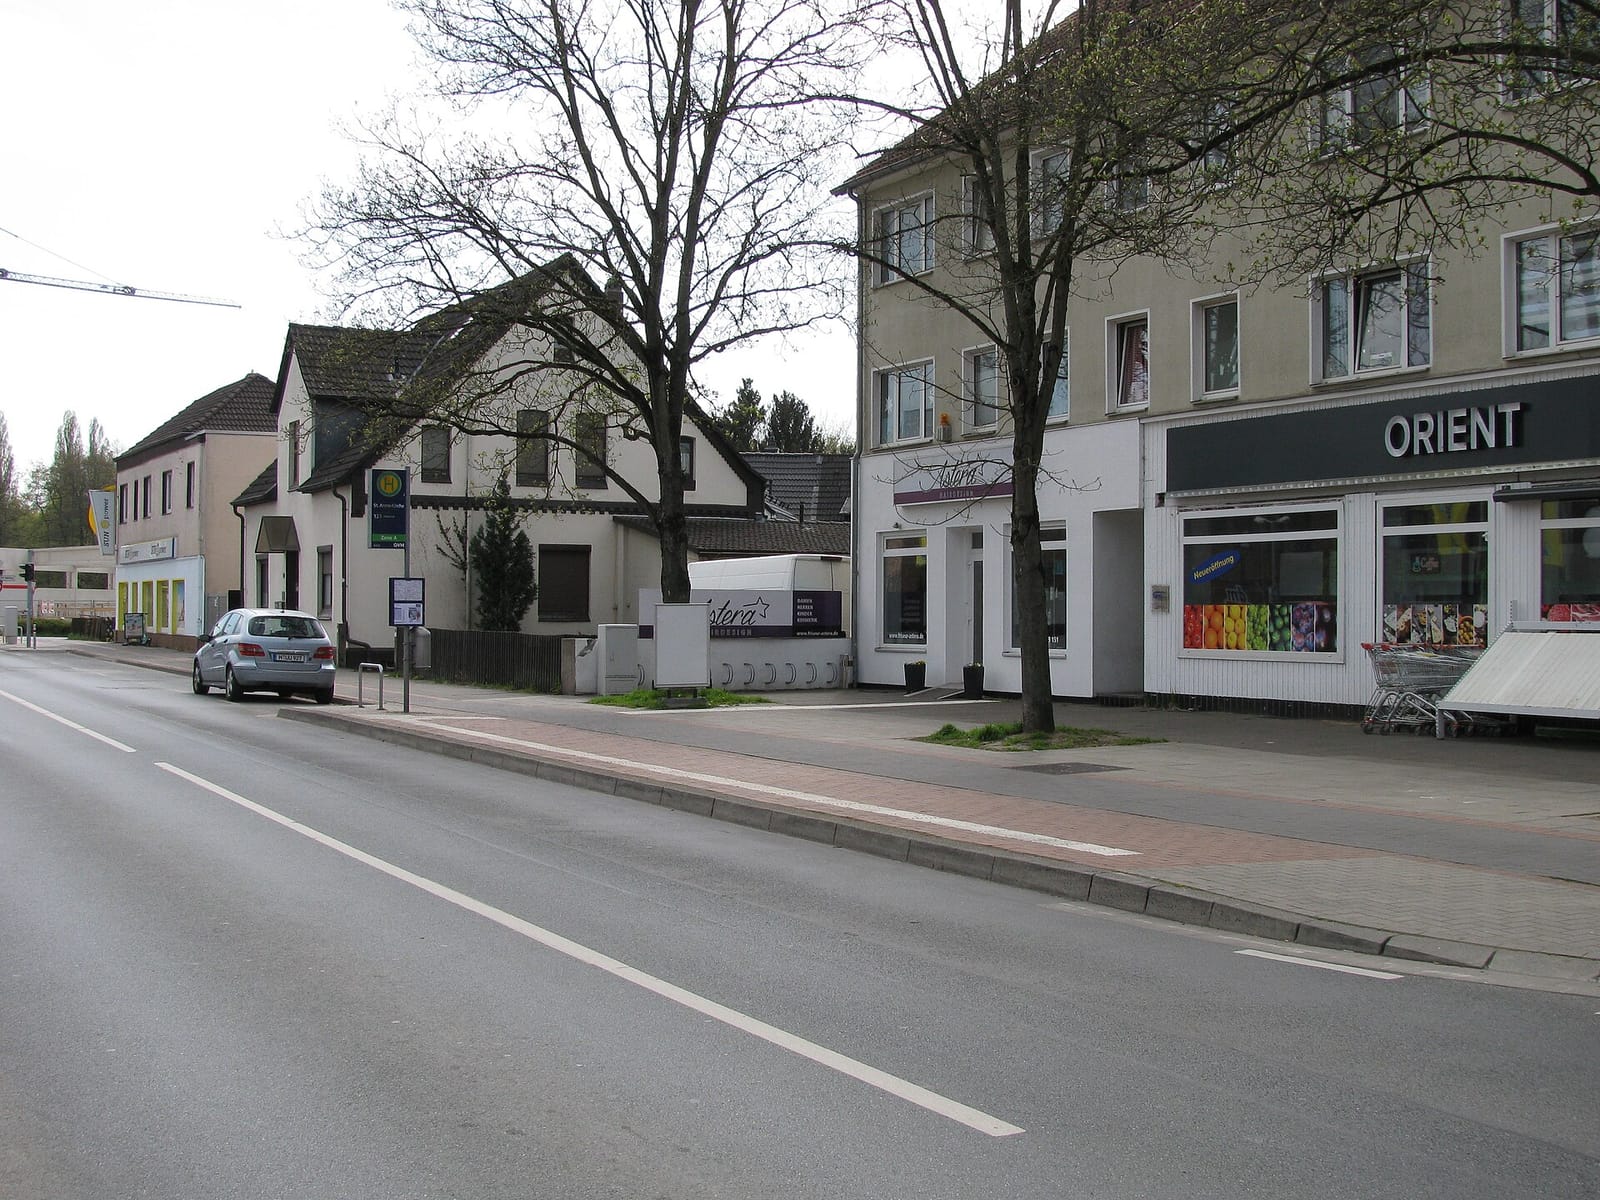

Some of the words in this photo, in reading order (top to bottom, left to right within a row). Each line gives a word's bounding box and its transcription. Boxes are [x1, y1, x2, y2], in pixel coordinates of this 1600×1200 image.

[1384, 402, 1521, 458] ORIENT
[1193, 555, 1234, 580] Neueröffnung
[707, 598, 757, 626] stera
